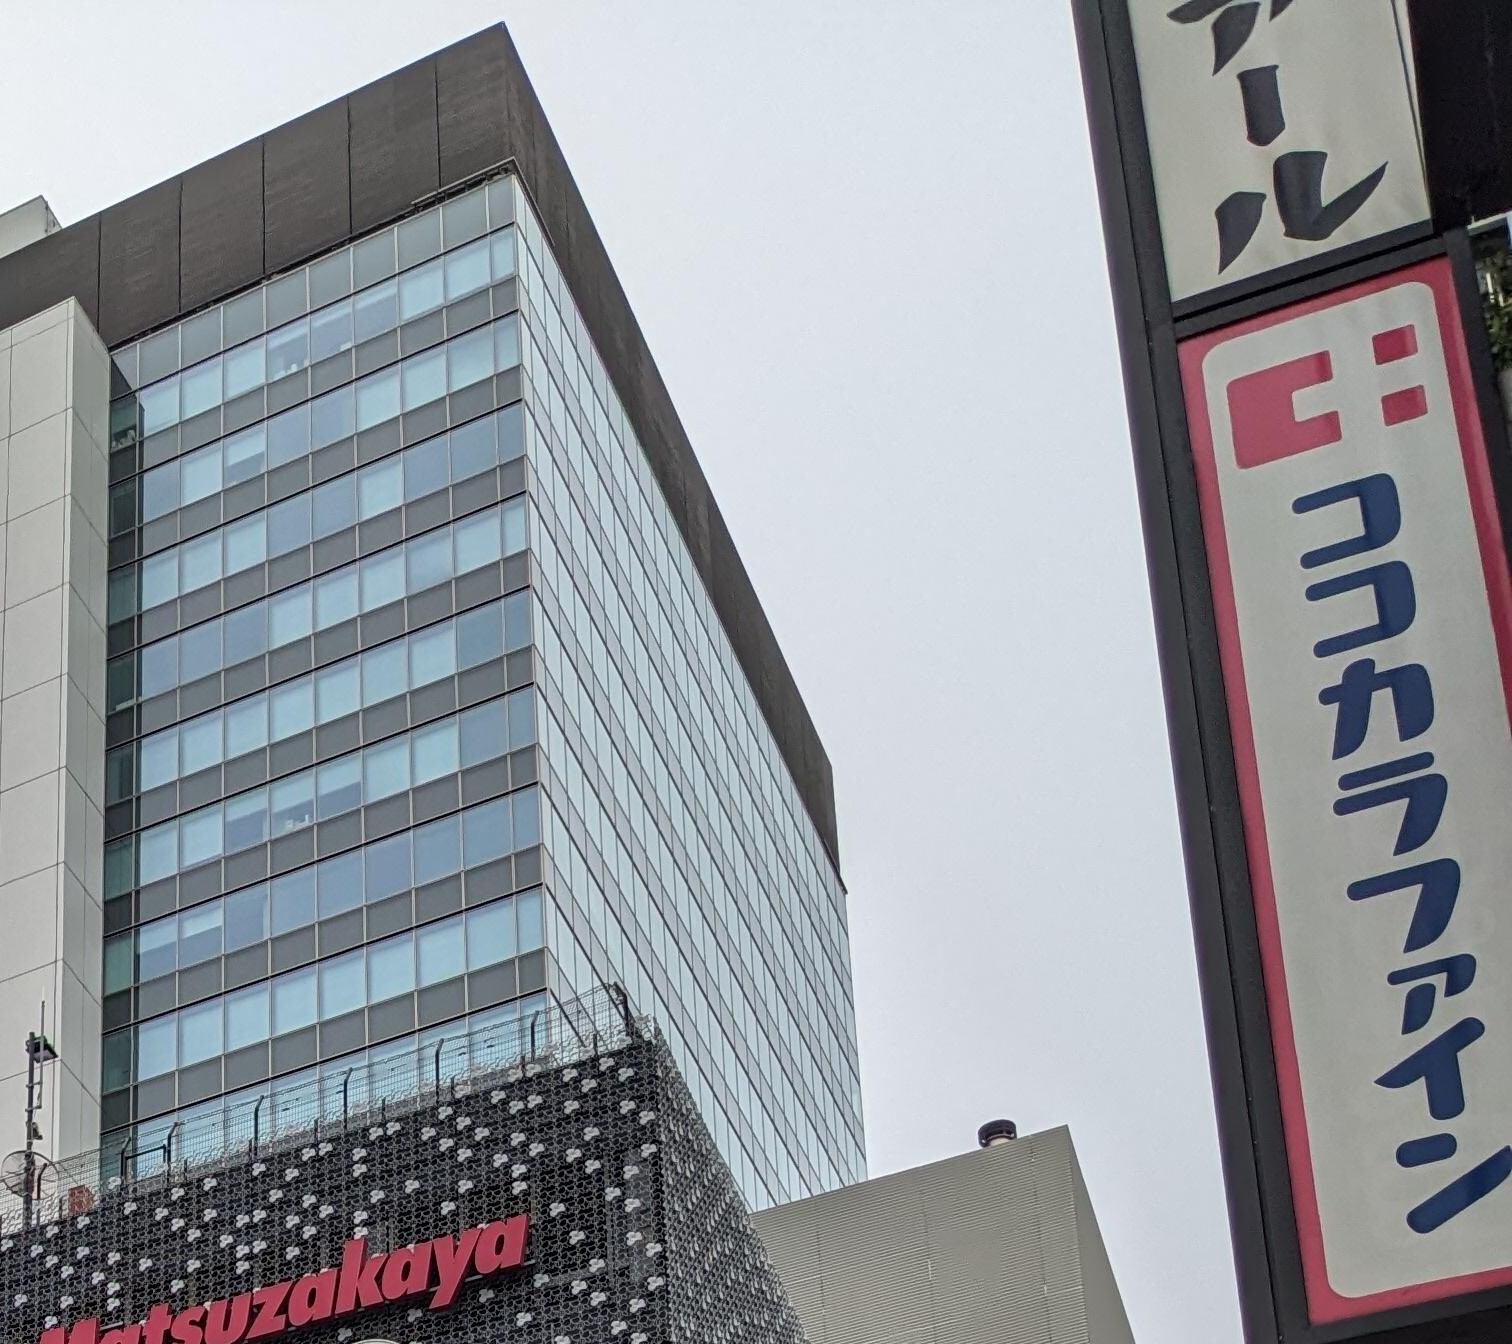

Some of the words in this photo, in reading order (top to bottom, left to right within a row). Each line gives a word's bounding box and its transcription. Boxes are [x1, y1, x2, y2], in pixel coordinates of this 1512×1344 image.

[1292, 473, 1512, 1234] ココカラファイン
